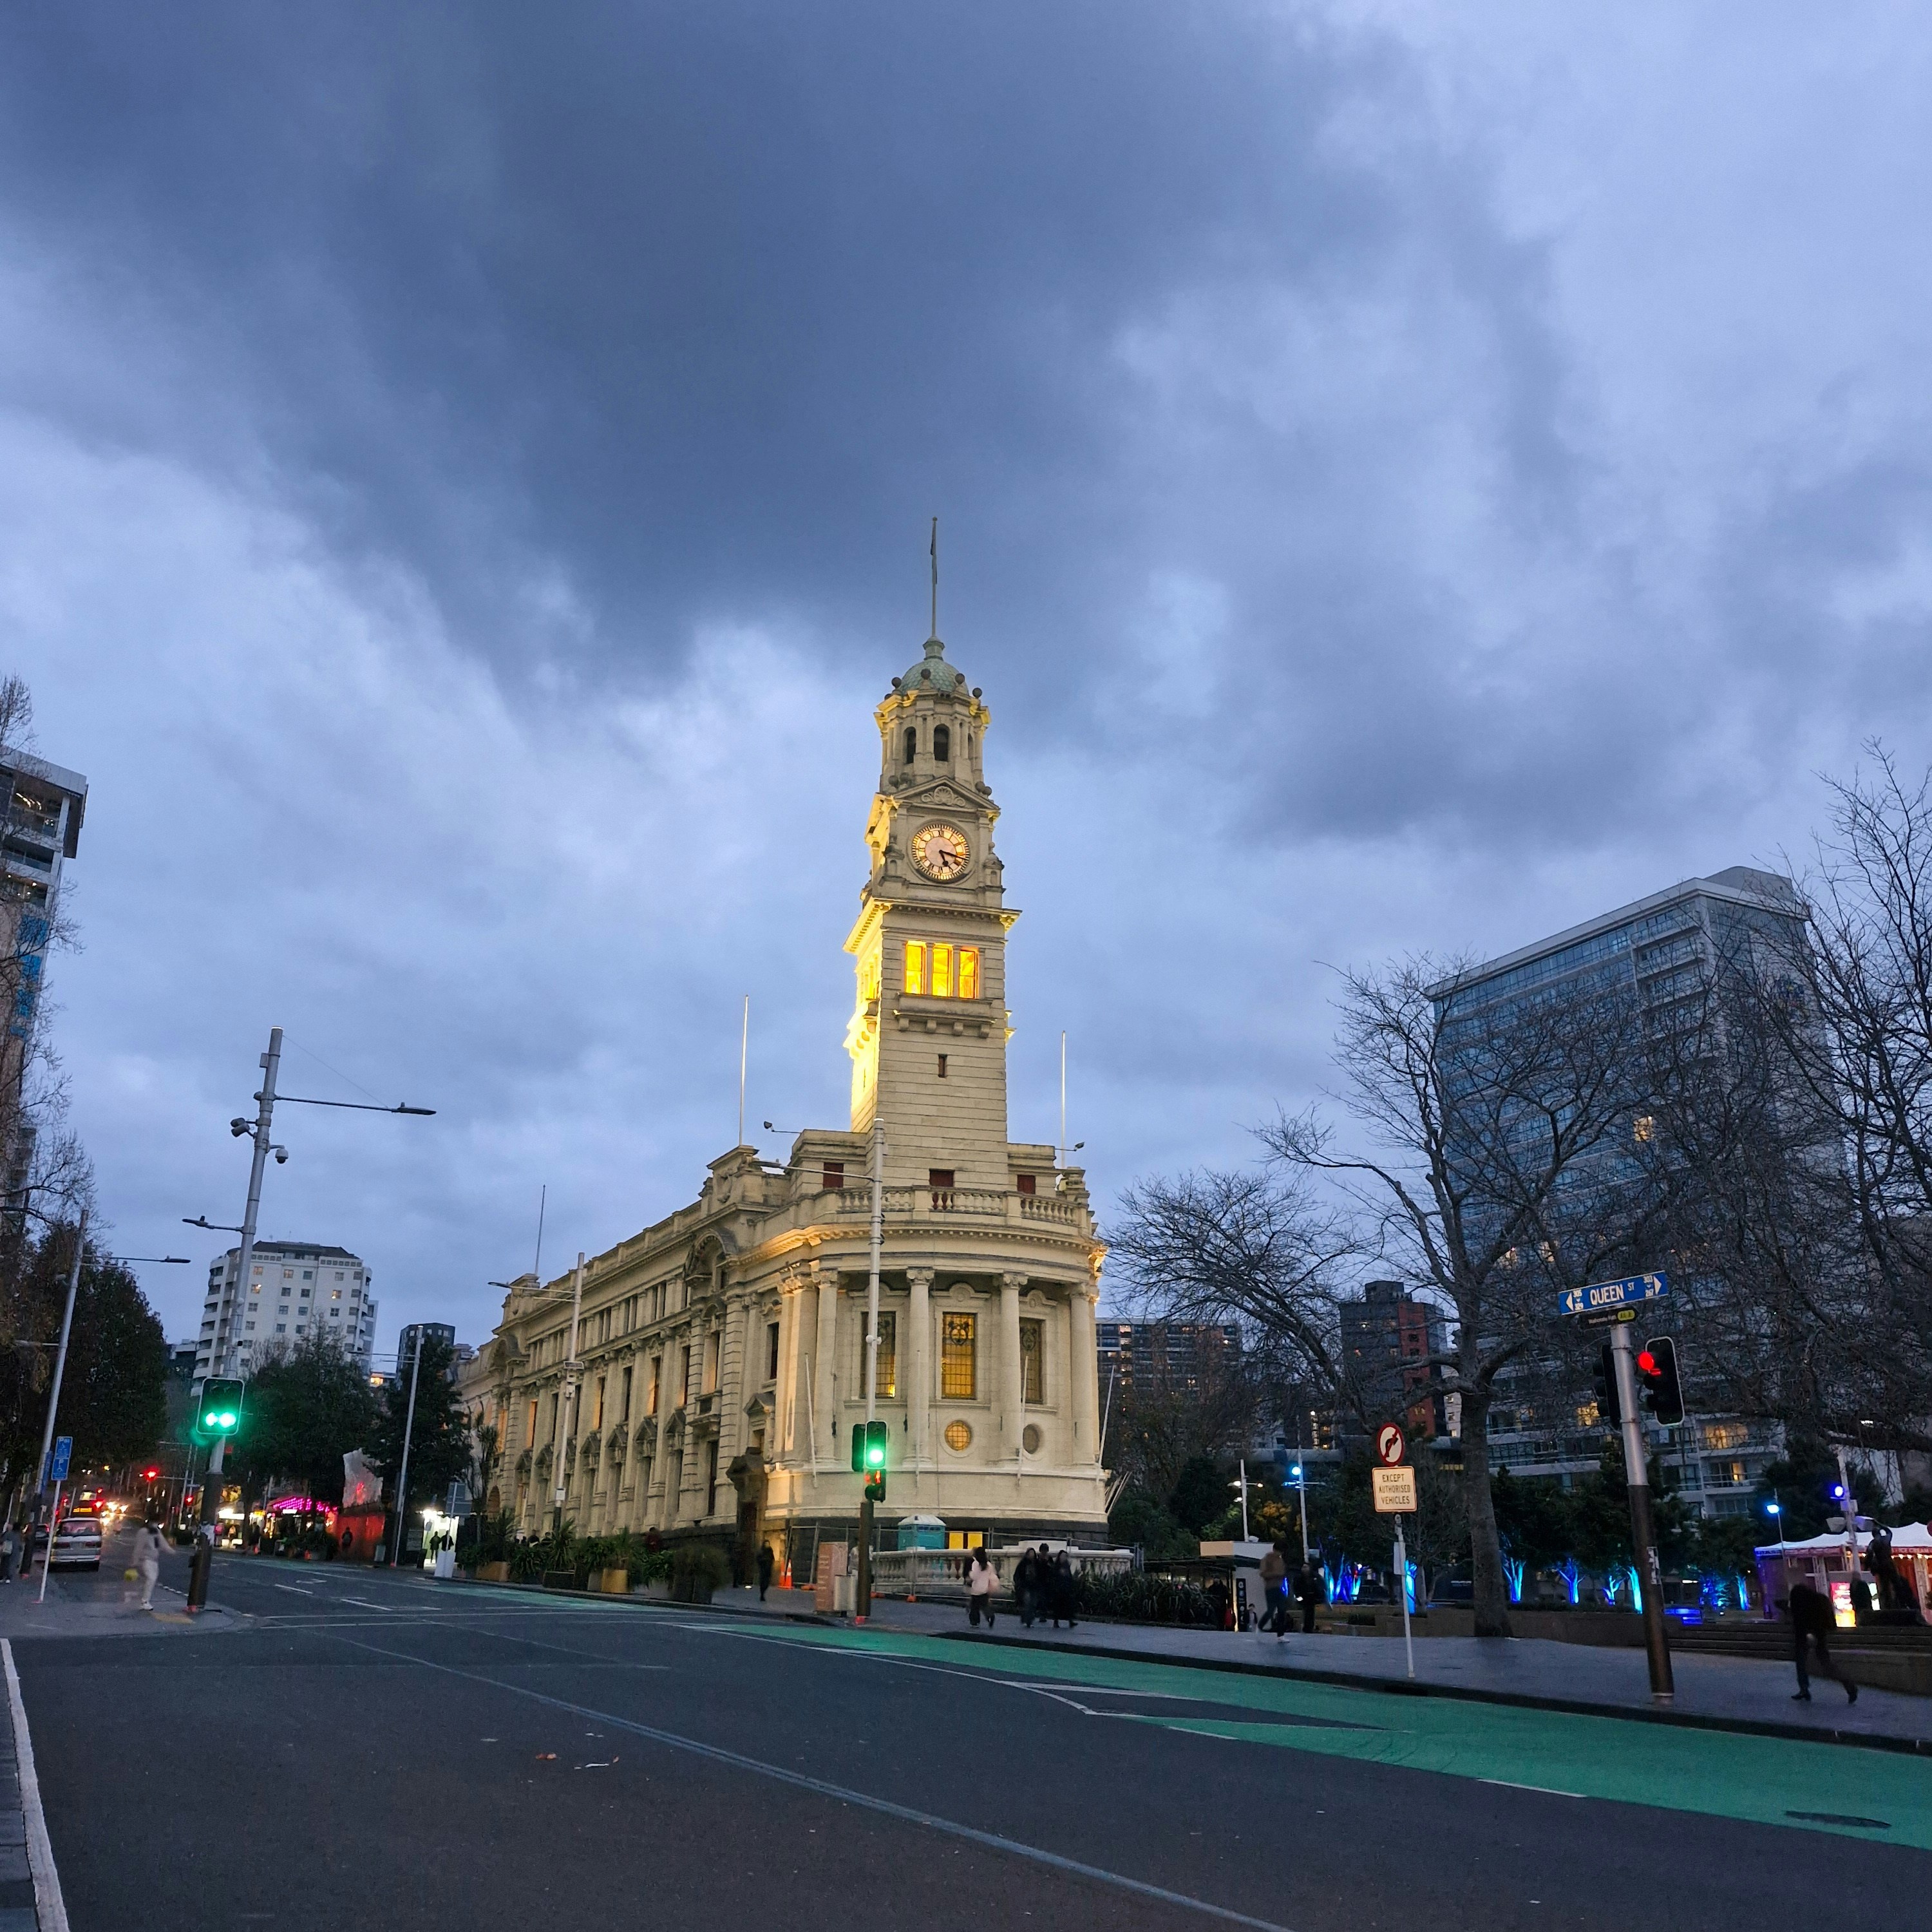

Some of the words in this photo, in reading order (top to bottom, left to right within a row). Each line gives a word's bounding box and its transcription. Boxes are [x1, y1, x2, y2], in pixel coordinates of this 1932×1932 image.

[1590, 1283, 1624, 1305] QUEEN
[1627, 1282, 1634, 1291] ST
[1382, 1473, 1405, 1482] EXCEPT
[1379, 1484, 1410, 1493] AUTHORISED
[1381, 1495, 1410, 1504] VEHICLES
